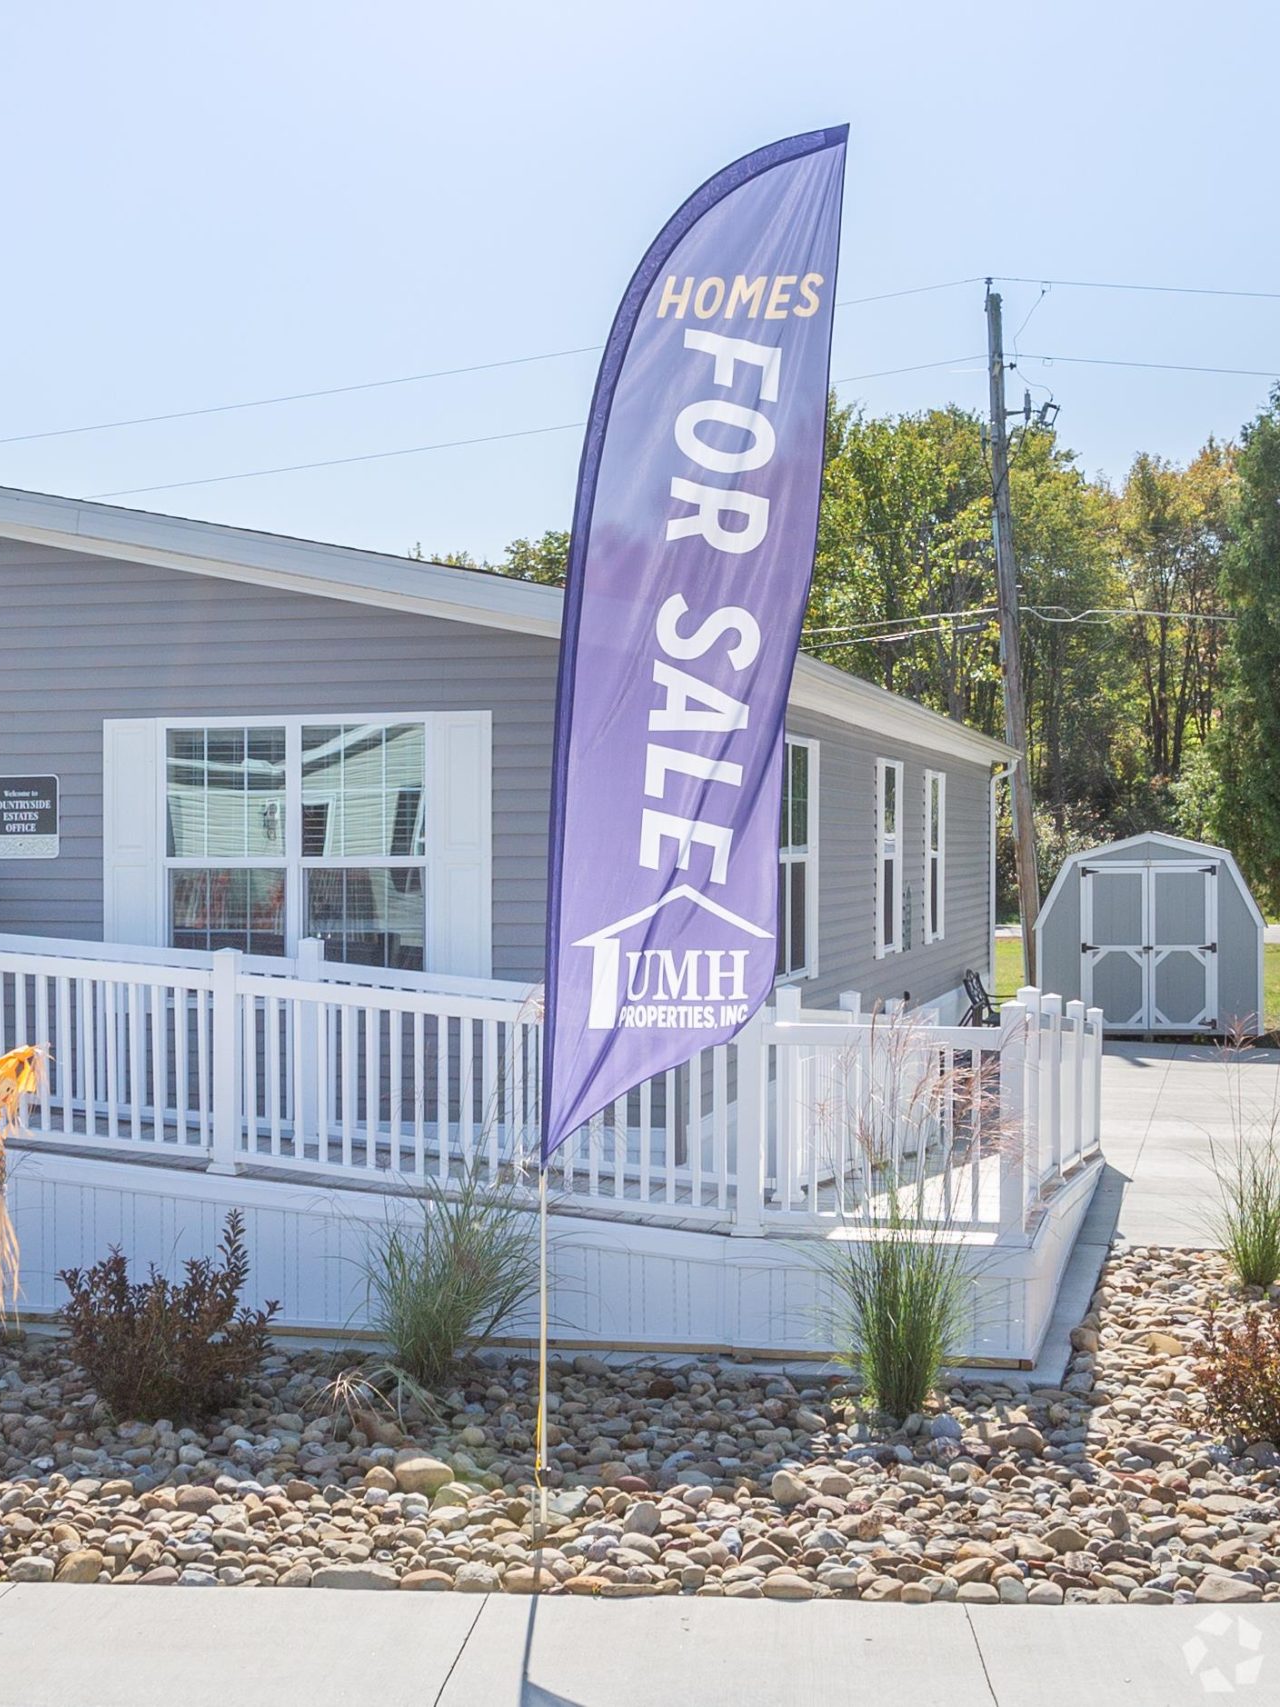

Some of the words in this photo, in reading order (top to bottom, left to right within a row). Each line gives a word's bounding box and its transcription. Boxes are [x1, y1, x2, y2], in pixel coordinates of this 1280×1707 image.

[656, 272, 825, 320] HOMES
[665, 328, 783, 554] FOR
[639, 592, 761, 885] SALE
[3, 811, 39, 821] ESTATES
[5, 823, 36, 833] OFFICE
[625, 949, 750, 1001] UMH
[618, 1004, 718, 1030] PROPERTIES,
[721, 1004, 749, 1027] INC
